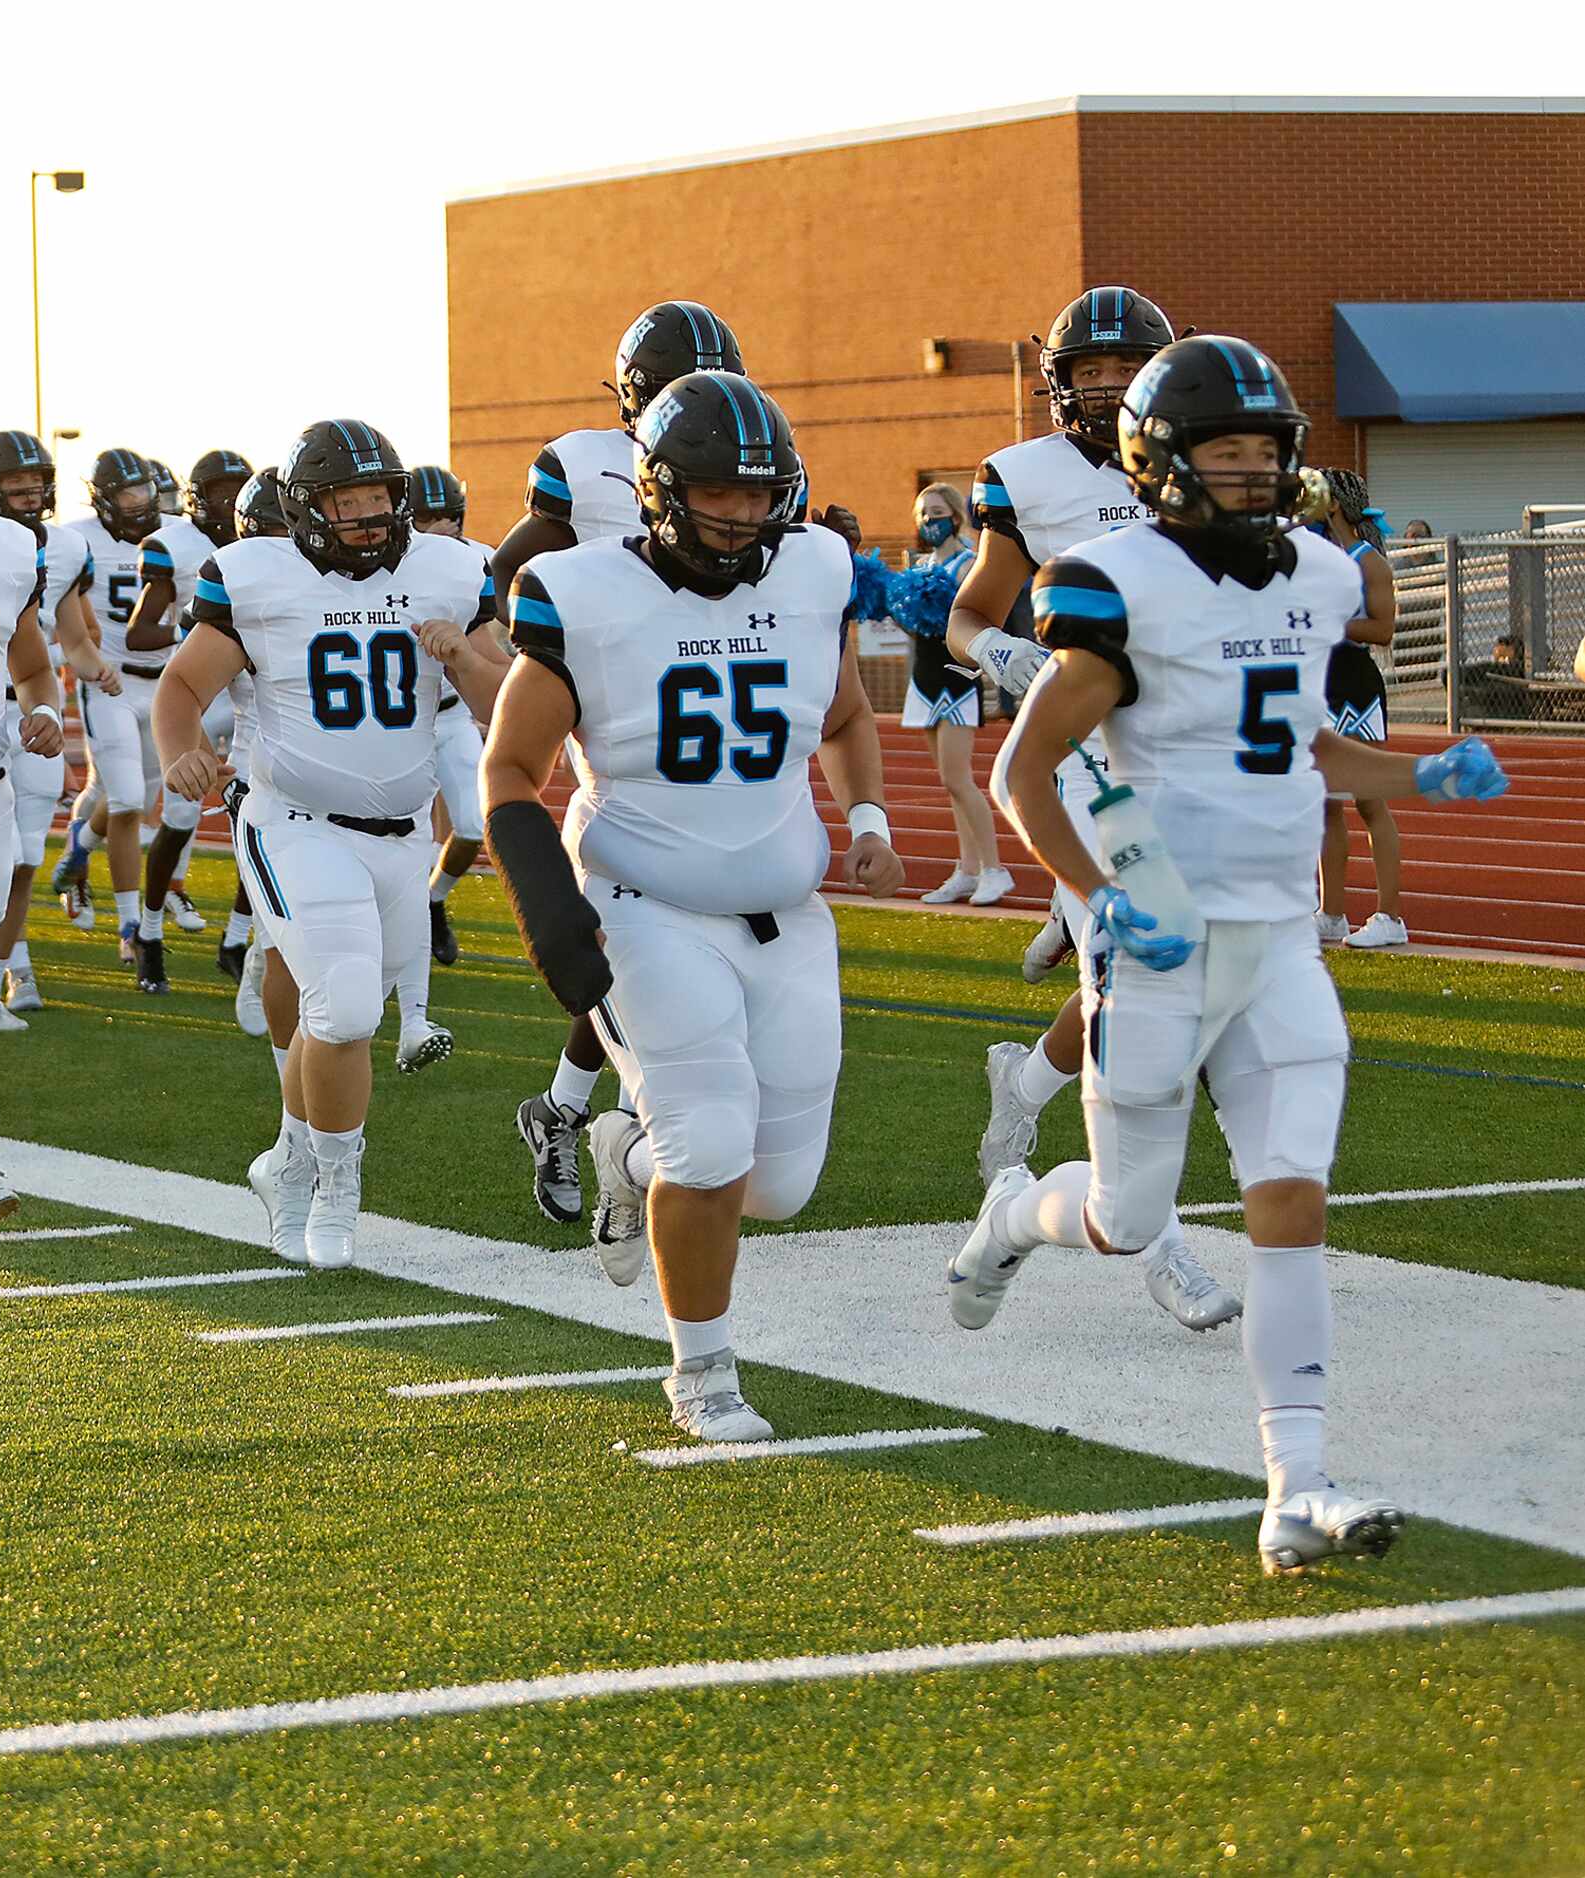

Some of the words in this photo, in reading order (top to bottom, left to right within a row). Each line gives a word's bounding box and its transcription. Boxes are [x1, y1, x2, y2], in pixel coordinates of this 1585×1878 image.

[737, 465, 776, 476] Riddell
[1098, 506, 1139, 522] ROCK
[107, 574, 137, 623] 5
[323, 612, 363, 627] ROCK
[366, 610, 401, 625] HILL
[677, 639, 723, 657] ROCK
[727, 637, 768, 654] HILL
[1221, 638, 1266, 660] ROCK
[1270, 637, 1306, 656] HILL
[307, 629, 419, 731] 60
[655, 658, 791, 785] 65
[1234, 661, 1301, 775] 5
